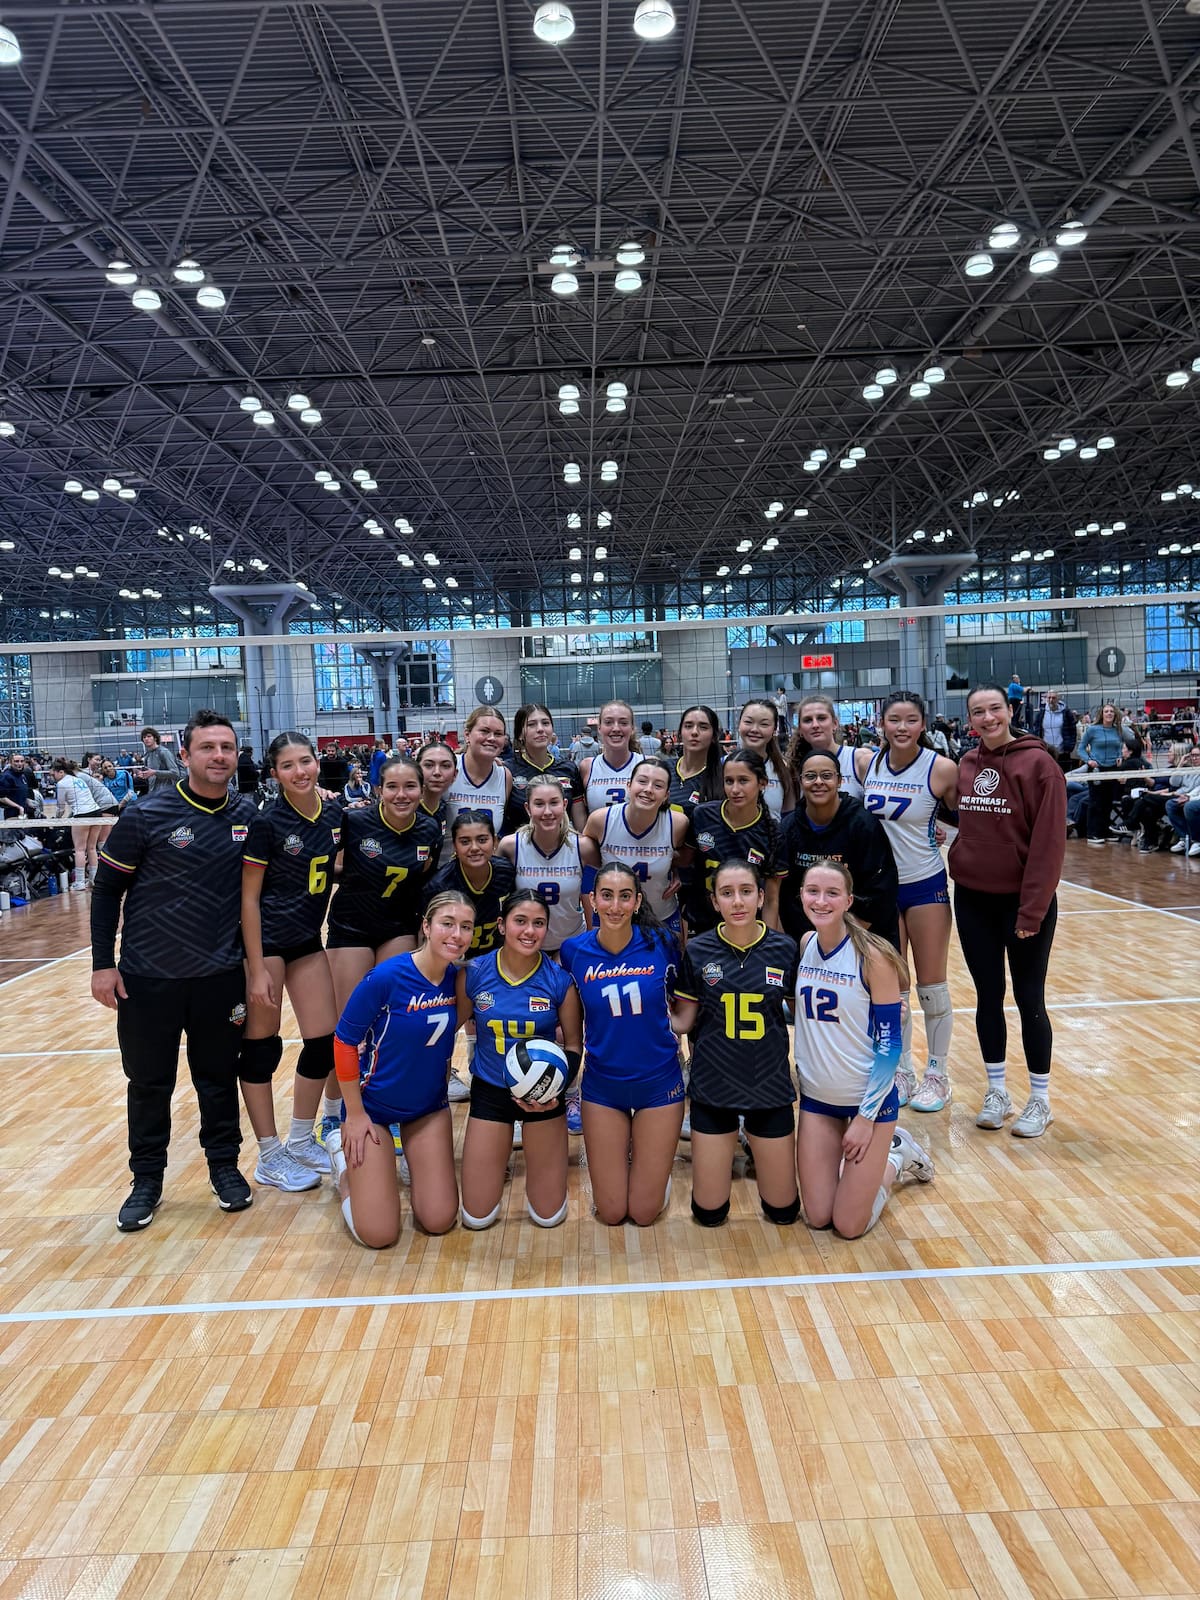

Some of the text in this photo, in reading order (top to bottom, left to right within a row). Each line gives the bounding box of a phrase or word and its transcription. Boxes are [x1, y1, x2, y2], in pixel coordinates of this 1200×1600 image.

[591, 777, 631, 786] NORTHE
[866, 780, 924, 794] NORTHEAST
[449, 791, 500, 805] NORTHEAST
[605, 788, 626, 807] 3
[867, 794, 912, 821] 27
[961, 796, 1007, 807] NORTHEAST
[993, 807, 1012, 815] CLUB
[603, 843, 670, 857] NORTHEAST
[308, 855, 329, 895] 6
[381, 865, 409, 898] 7
[519, 865, 578, 877] NORTHEAST
[632, 861, 652, 883] 4
[537, 882, 560, 905] 8
[584, 963, 655, 984] Northeast
[601, 981, 642, 1017] 11
[800, 985, 840, 1024] 12
[720, 992, 766, 1040] 15
[426, 1012, 449, 1047] 7
[487, 1019, 535, 1055] 14
